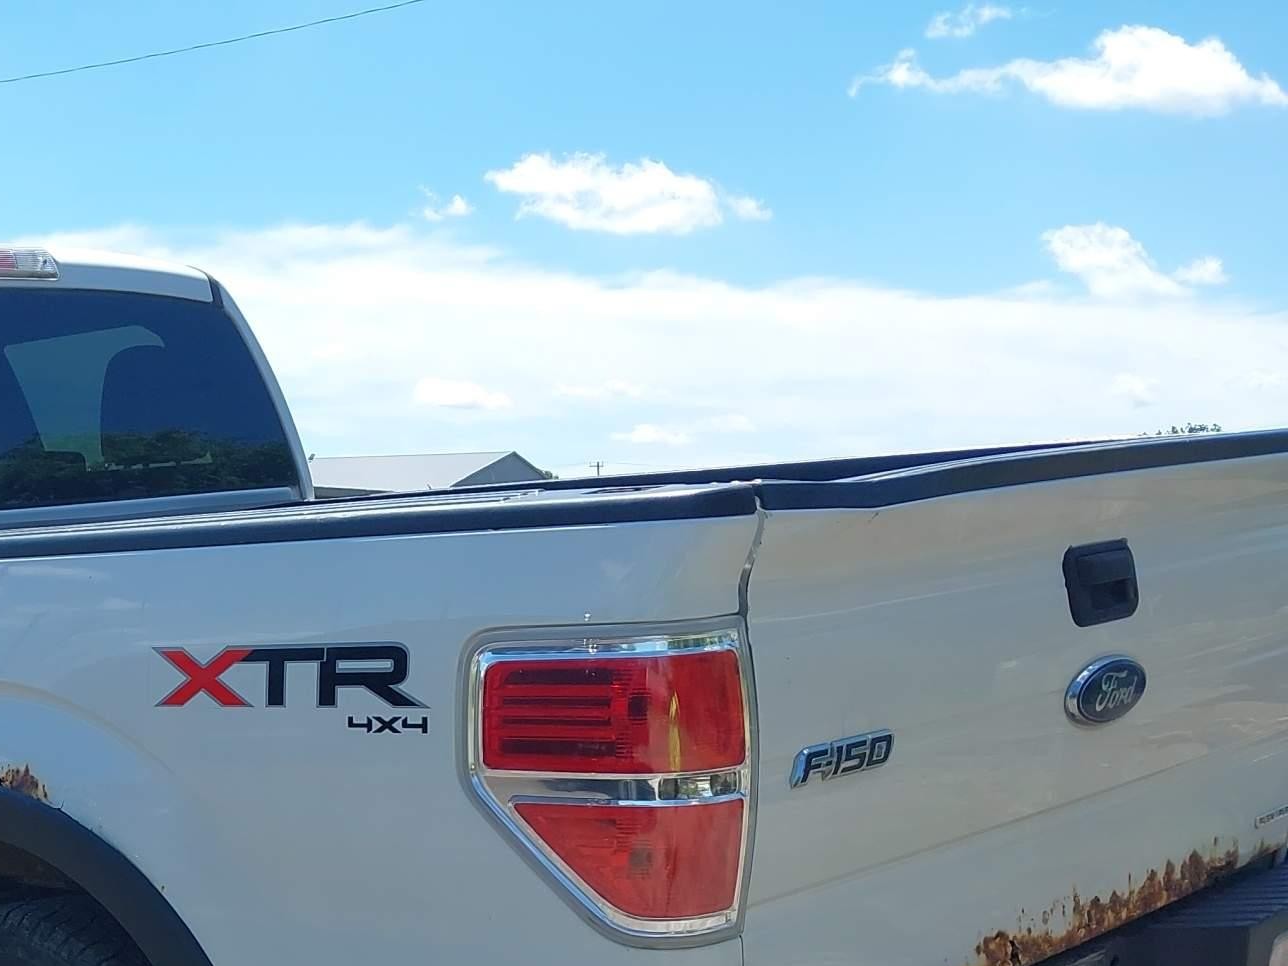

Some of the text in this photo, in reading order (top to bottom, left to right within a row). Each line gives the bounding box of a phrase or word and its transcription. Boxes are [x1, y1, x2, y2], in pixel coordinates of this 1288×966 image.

[152, 641, 430, 708] XTR
[1095, 670, 1138, 712] Ford
[793, 731, 894, 786] F-150
